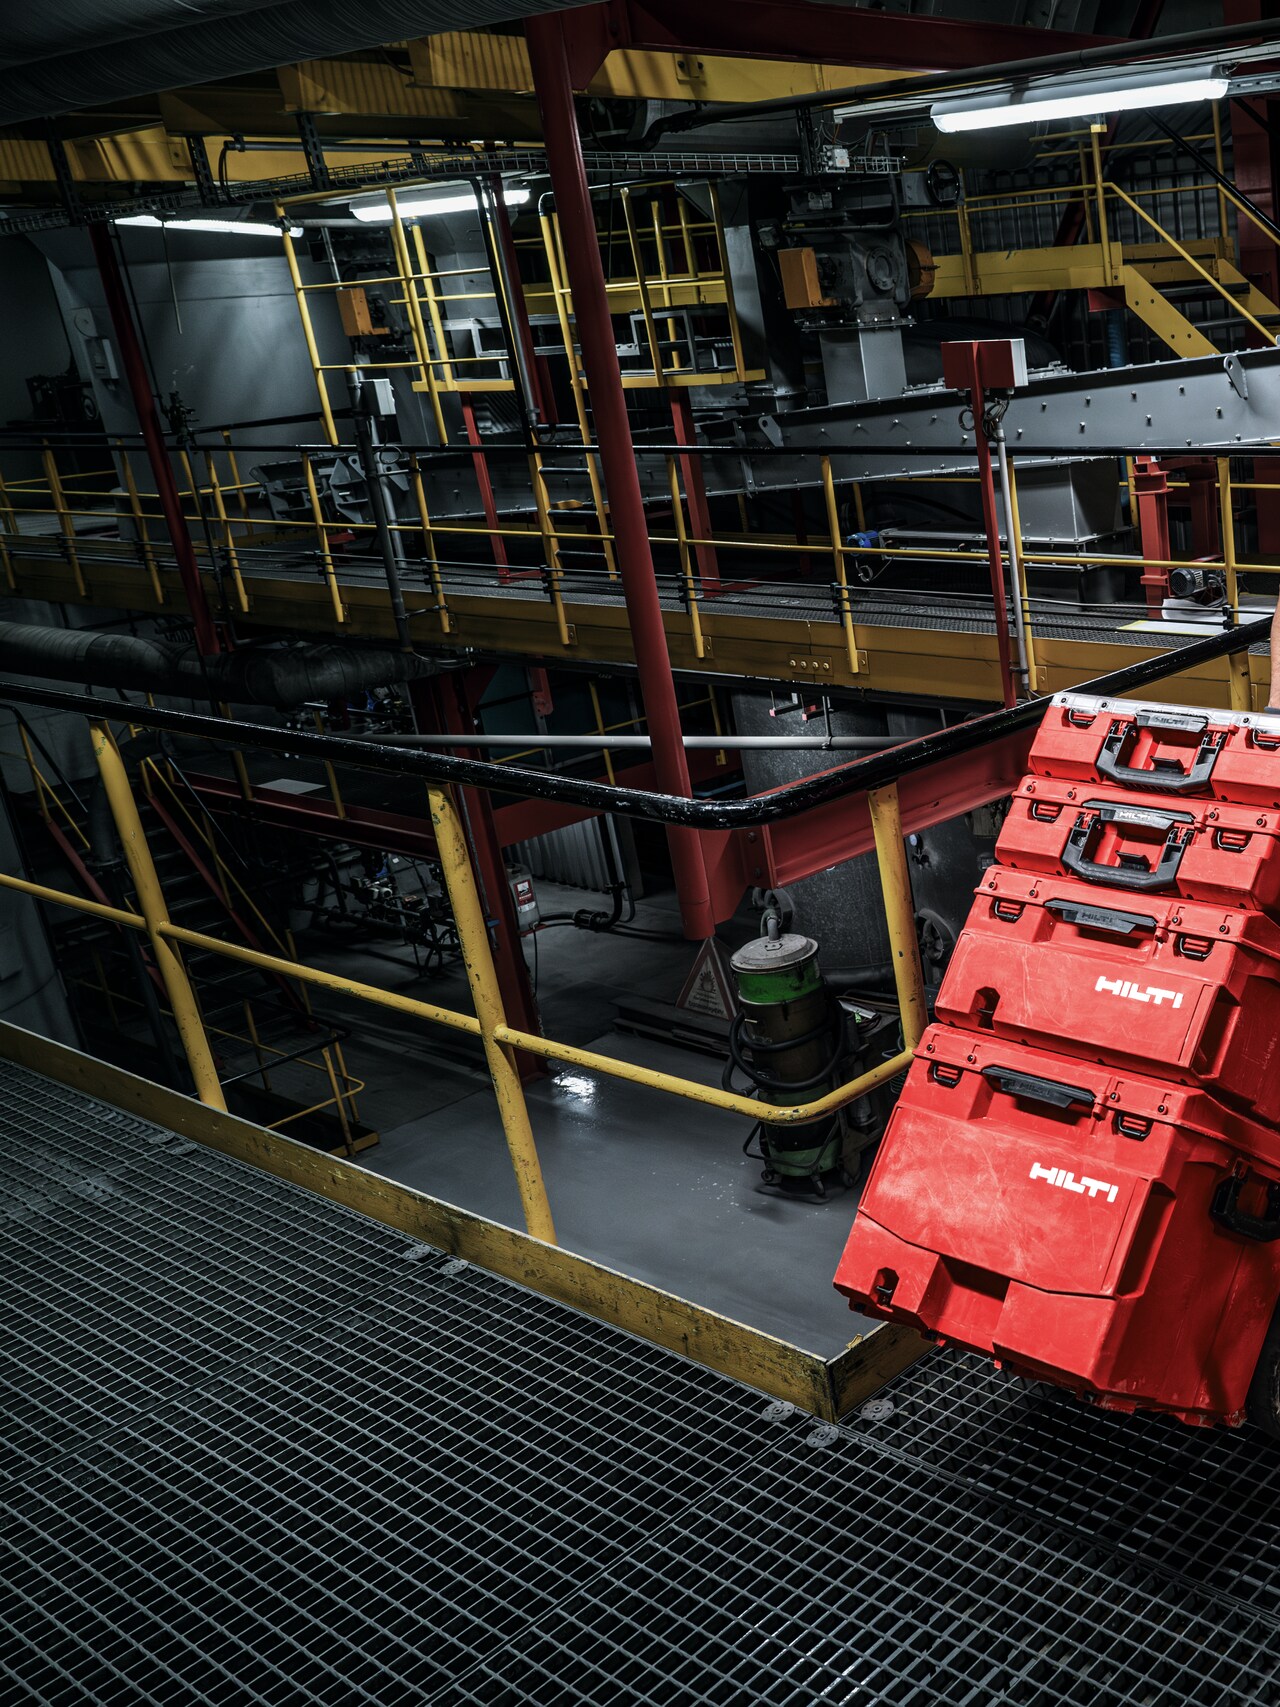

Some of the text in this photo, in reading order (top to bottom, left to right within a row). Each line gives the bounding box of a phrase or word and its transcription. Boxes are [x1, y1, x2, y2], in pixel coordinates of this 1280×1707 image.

[1081, 912, 1113, 923] HILTI
[1095, 976, 1184, 1009] HILTI
[1029, 1162, 1119, 1203] HILTI
